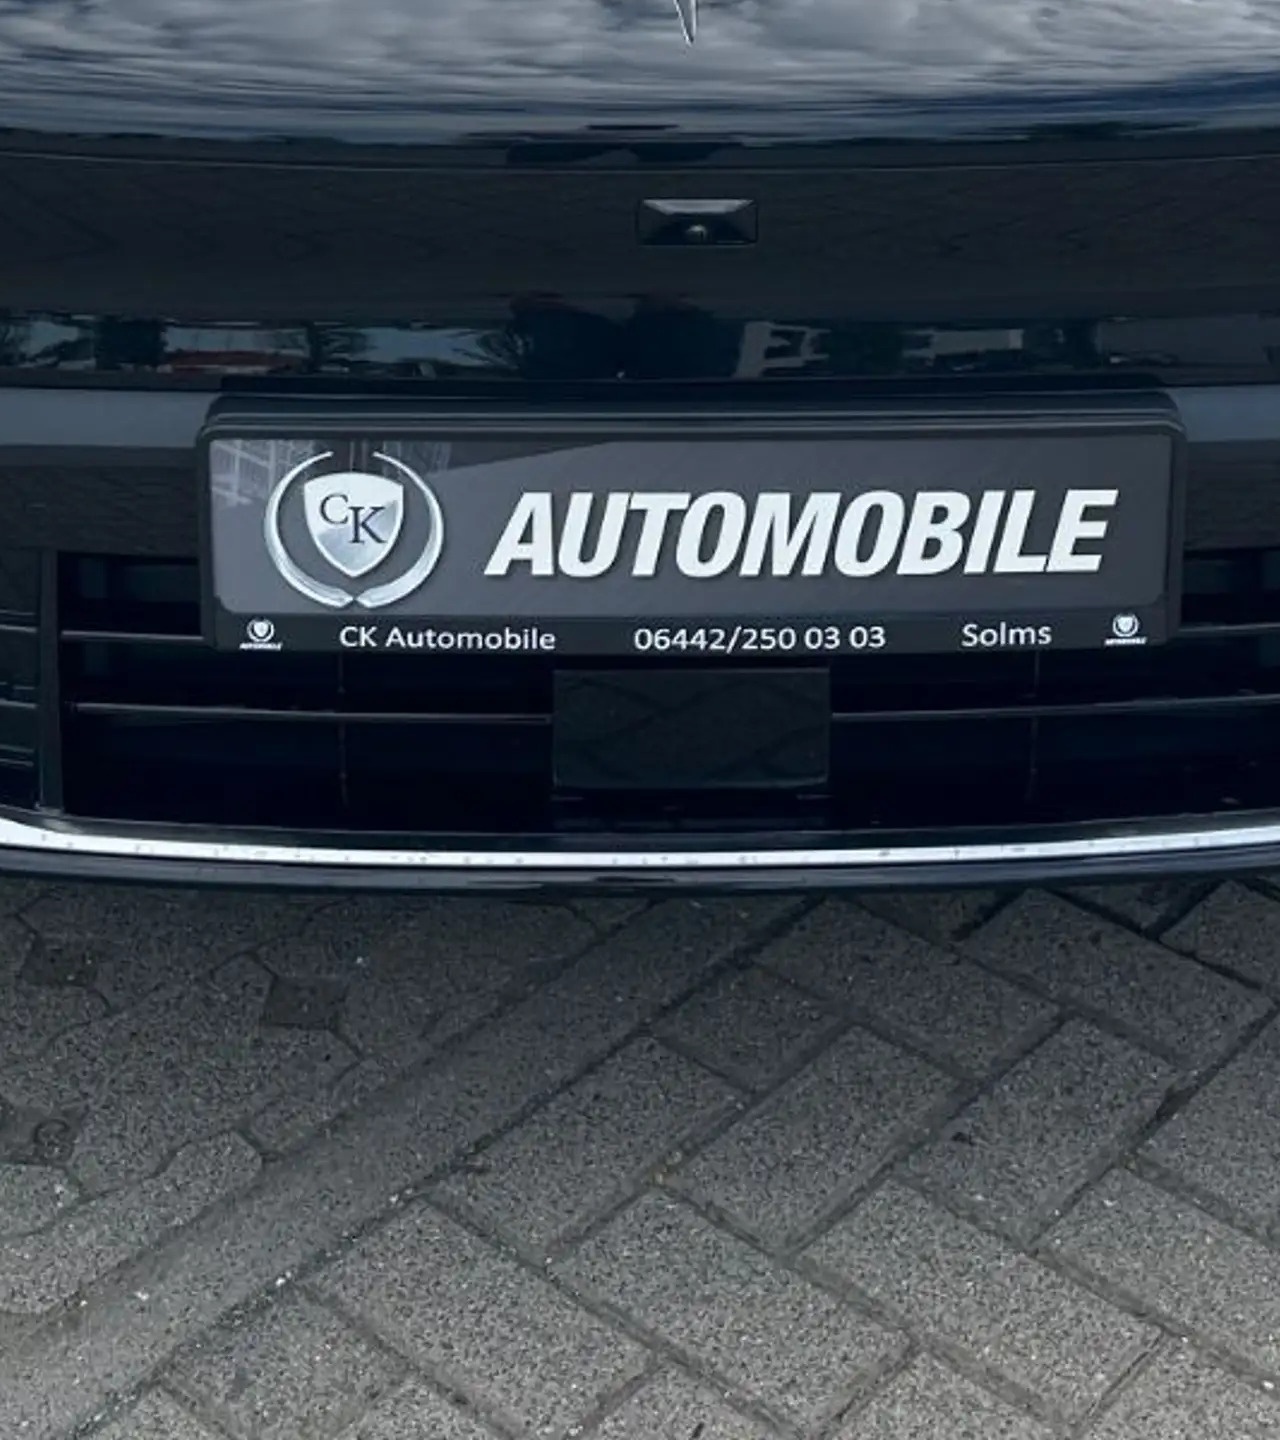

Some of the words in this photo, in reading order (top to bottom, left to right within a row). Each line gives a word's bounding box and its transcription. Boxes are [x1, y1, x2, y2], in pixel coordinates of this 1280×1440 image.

[484, 489, 1119, 578] AUTOMOBILE
[339, 626, 377, 648] CK
[385, 626, 556, 650] Automobile
[634, 626, 796, 654] 06442/250
[804, 626, 840, 650] 03
[849, 626, 886, 648] 03
[962, 621, 1052, 647] Solms
